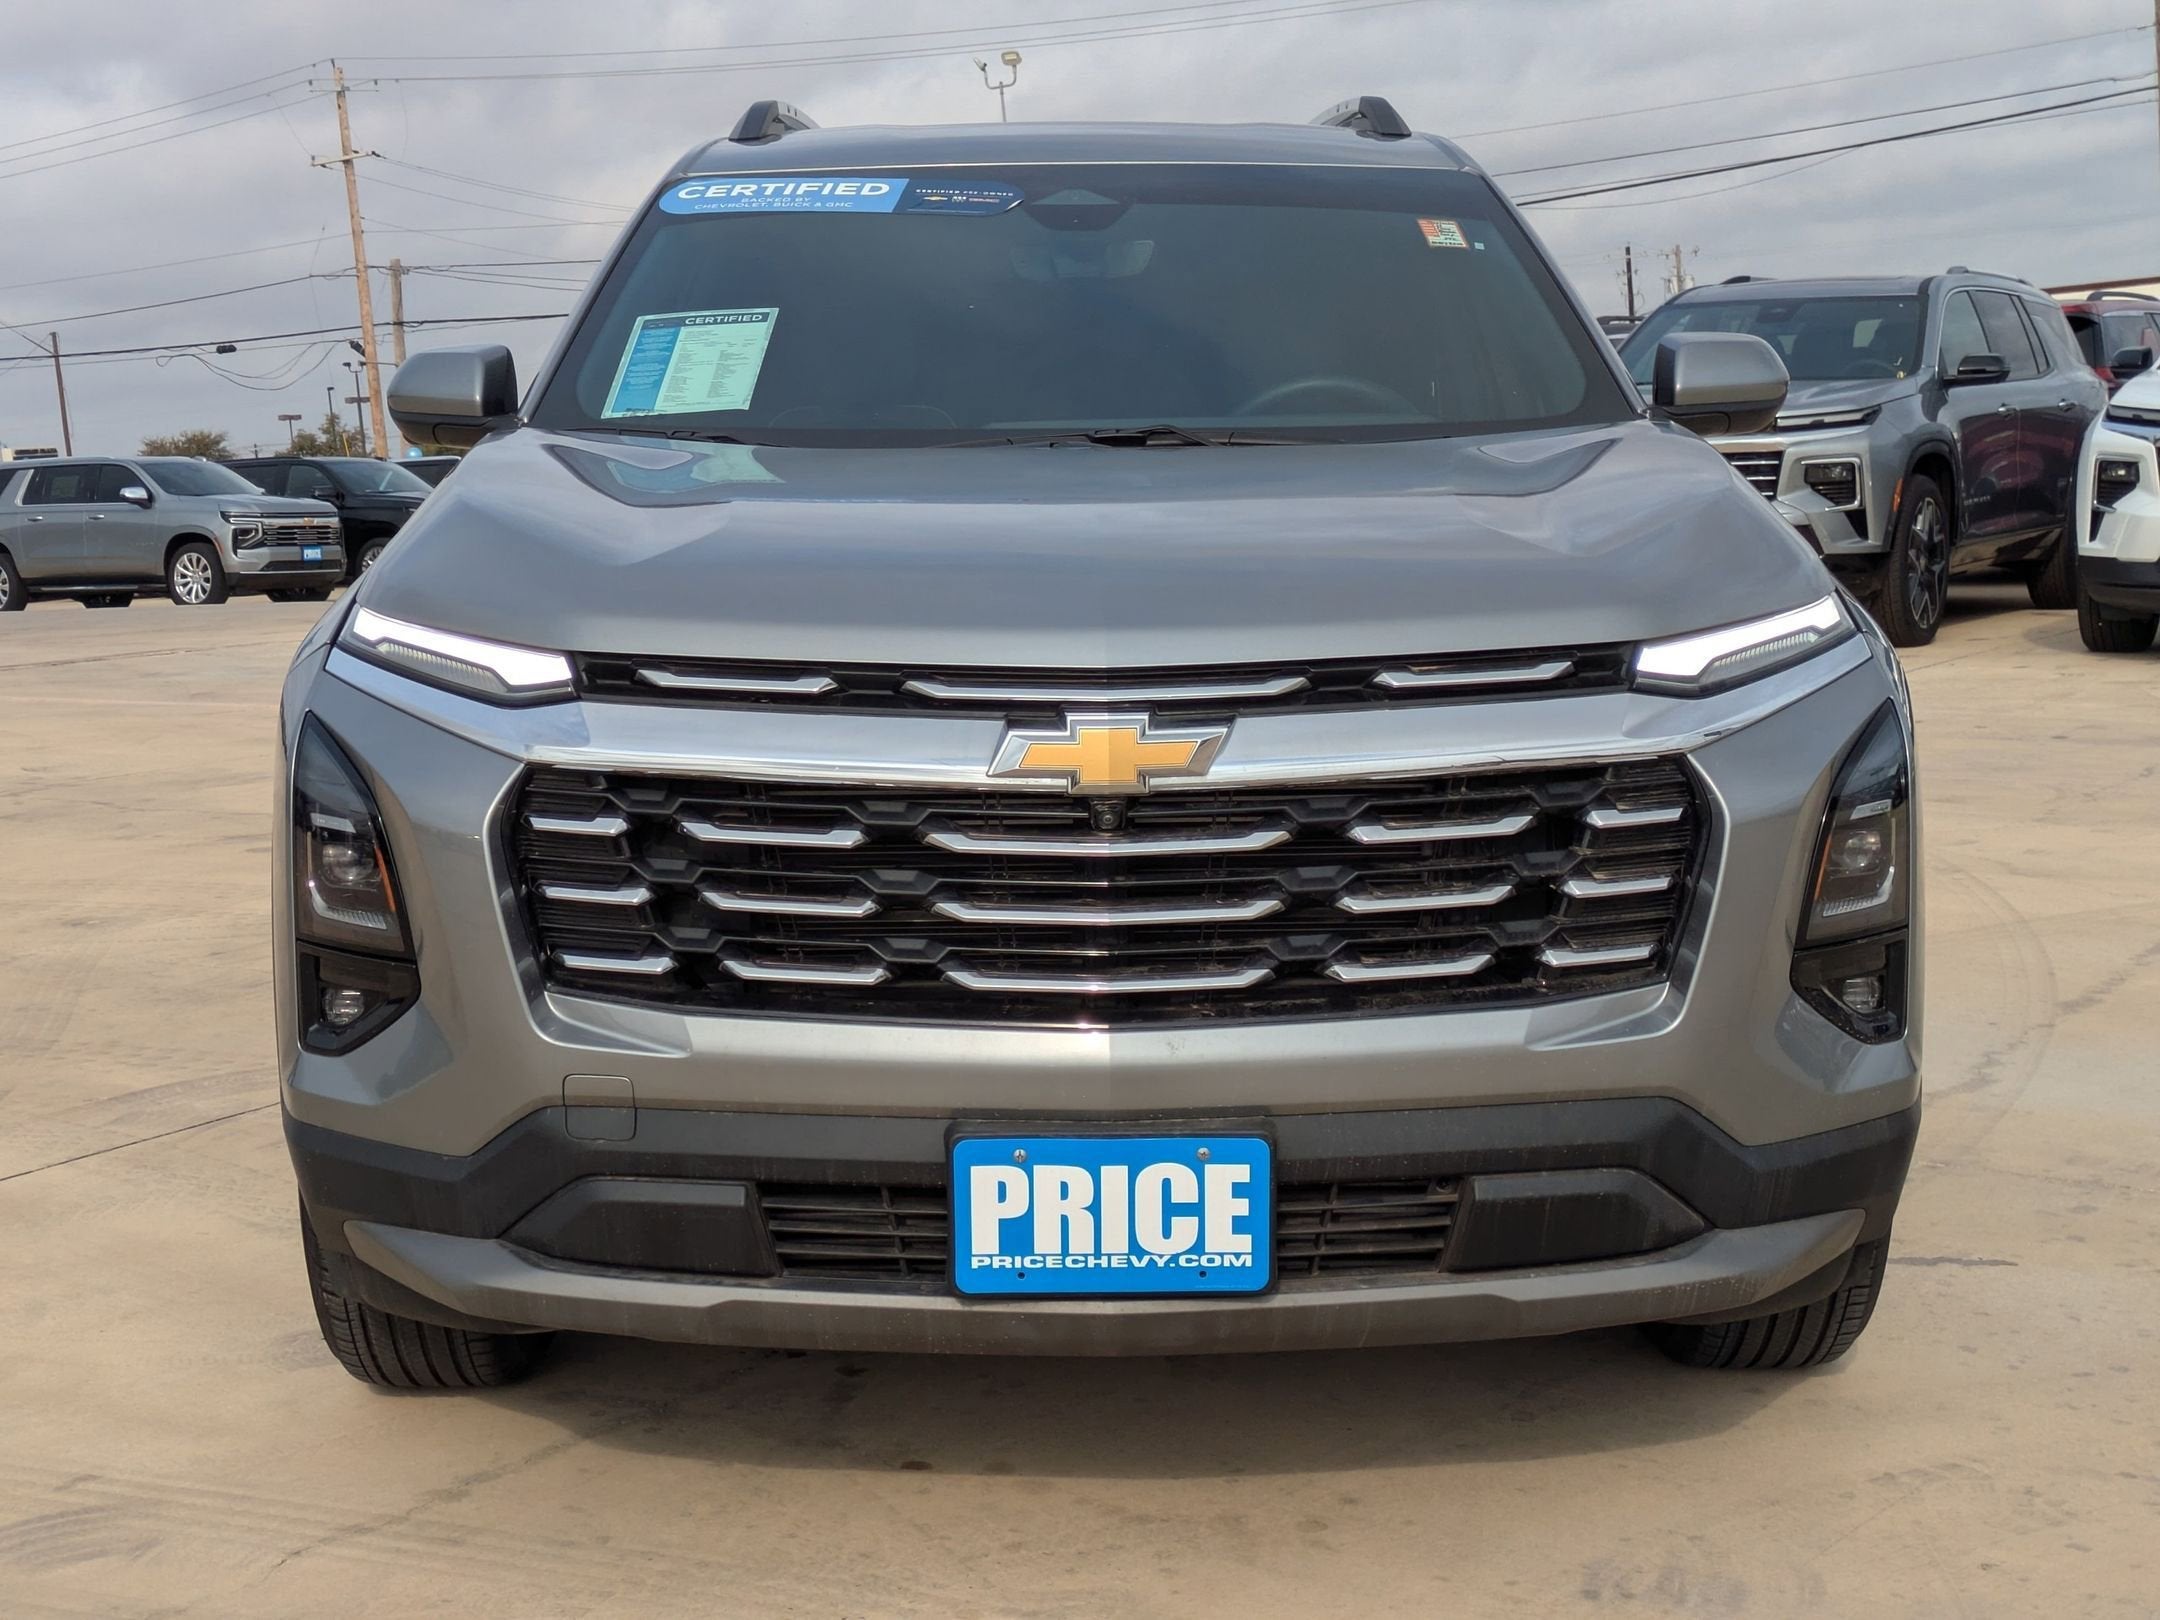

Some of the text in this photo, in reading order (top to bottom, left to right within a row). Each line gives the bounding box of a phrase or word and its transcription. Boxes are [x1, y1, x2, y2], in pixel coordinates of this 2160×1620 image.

[677, 182, 890, 199] CERTIFIED
[685, 314, 763, 325] CERTIFIED
[970, 1162, 1253, 1254] PRICE
[971, 1254, 1253, 1269] PRICECHEVY.COM
